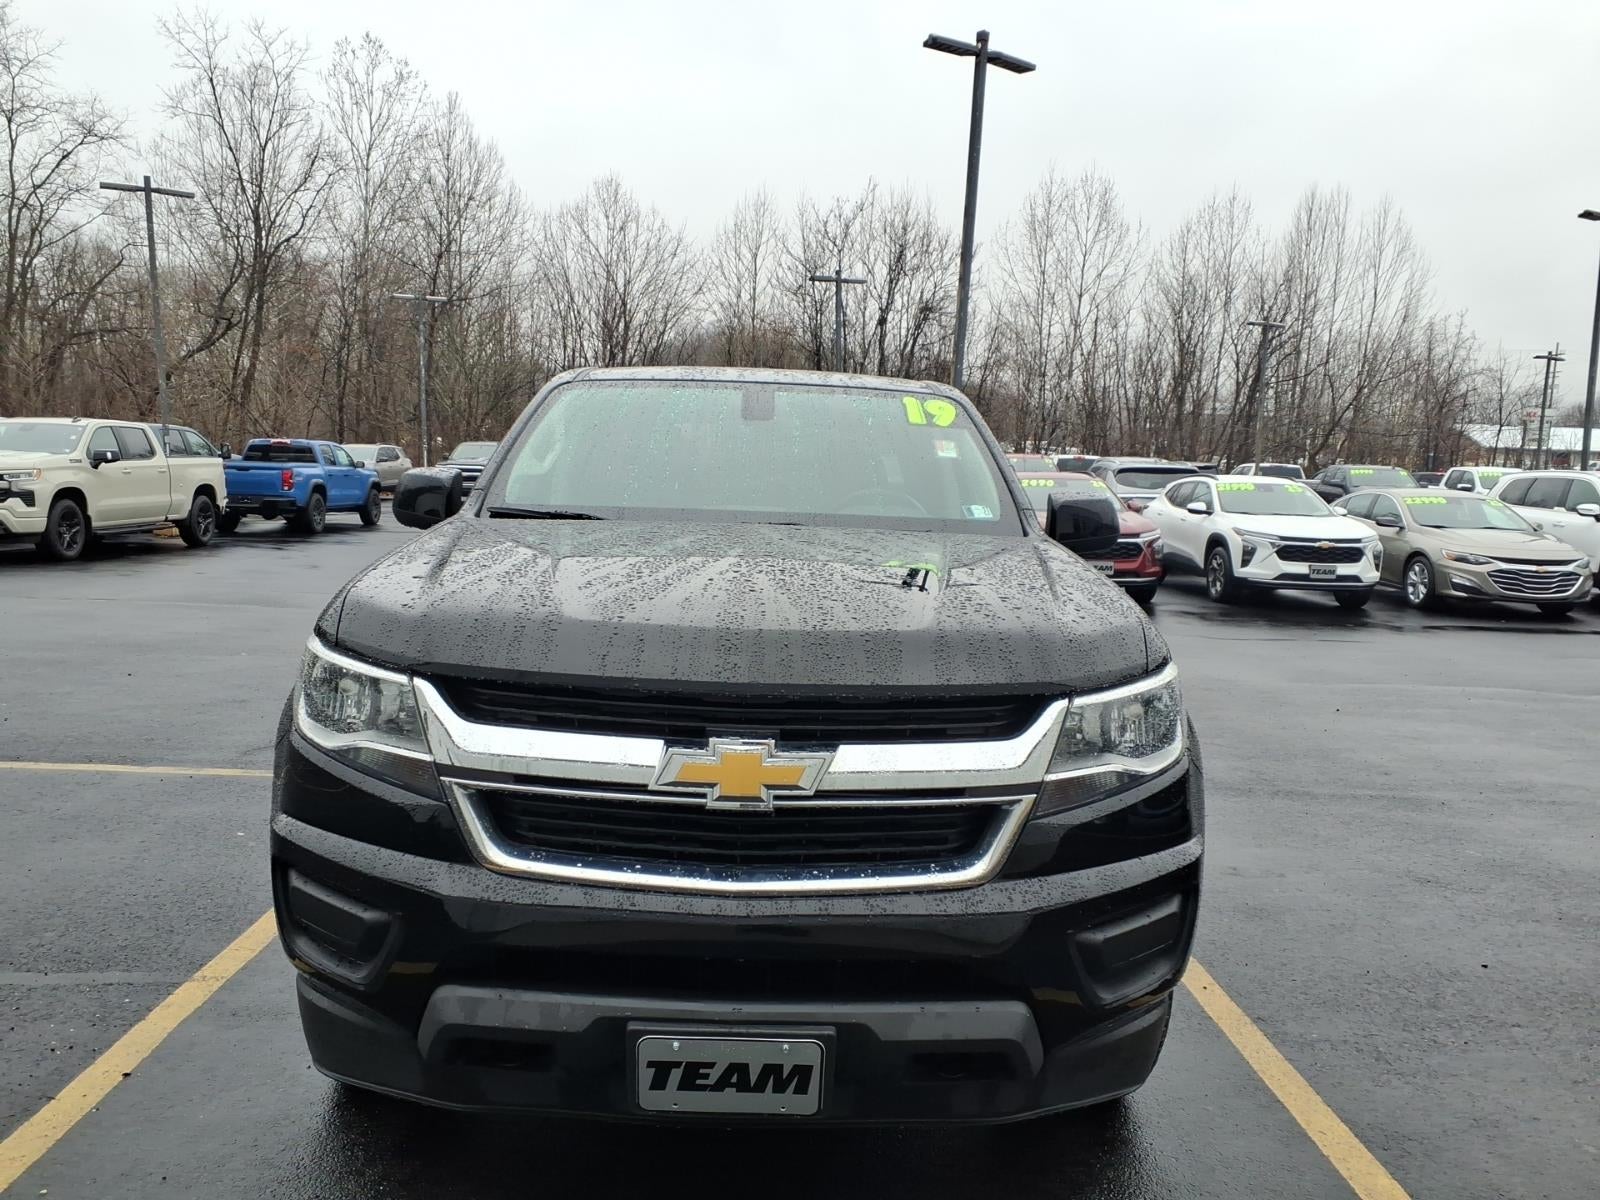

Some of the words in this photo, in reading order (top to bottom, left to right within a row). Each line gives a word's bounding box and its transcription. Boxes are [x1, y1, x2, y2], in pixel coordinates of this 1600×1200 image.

[903, 396, 956, 427] 19
[1311, 568, 1335, 576] TEAM
[646, 1060, 814, 1095] TEAM
